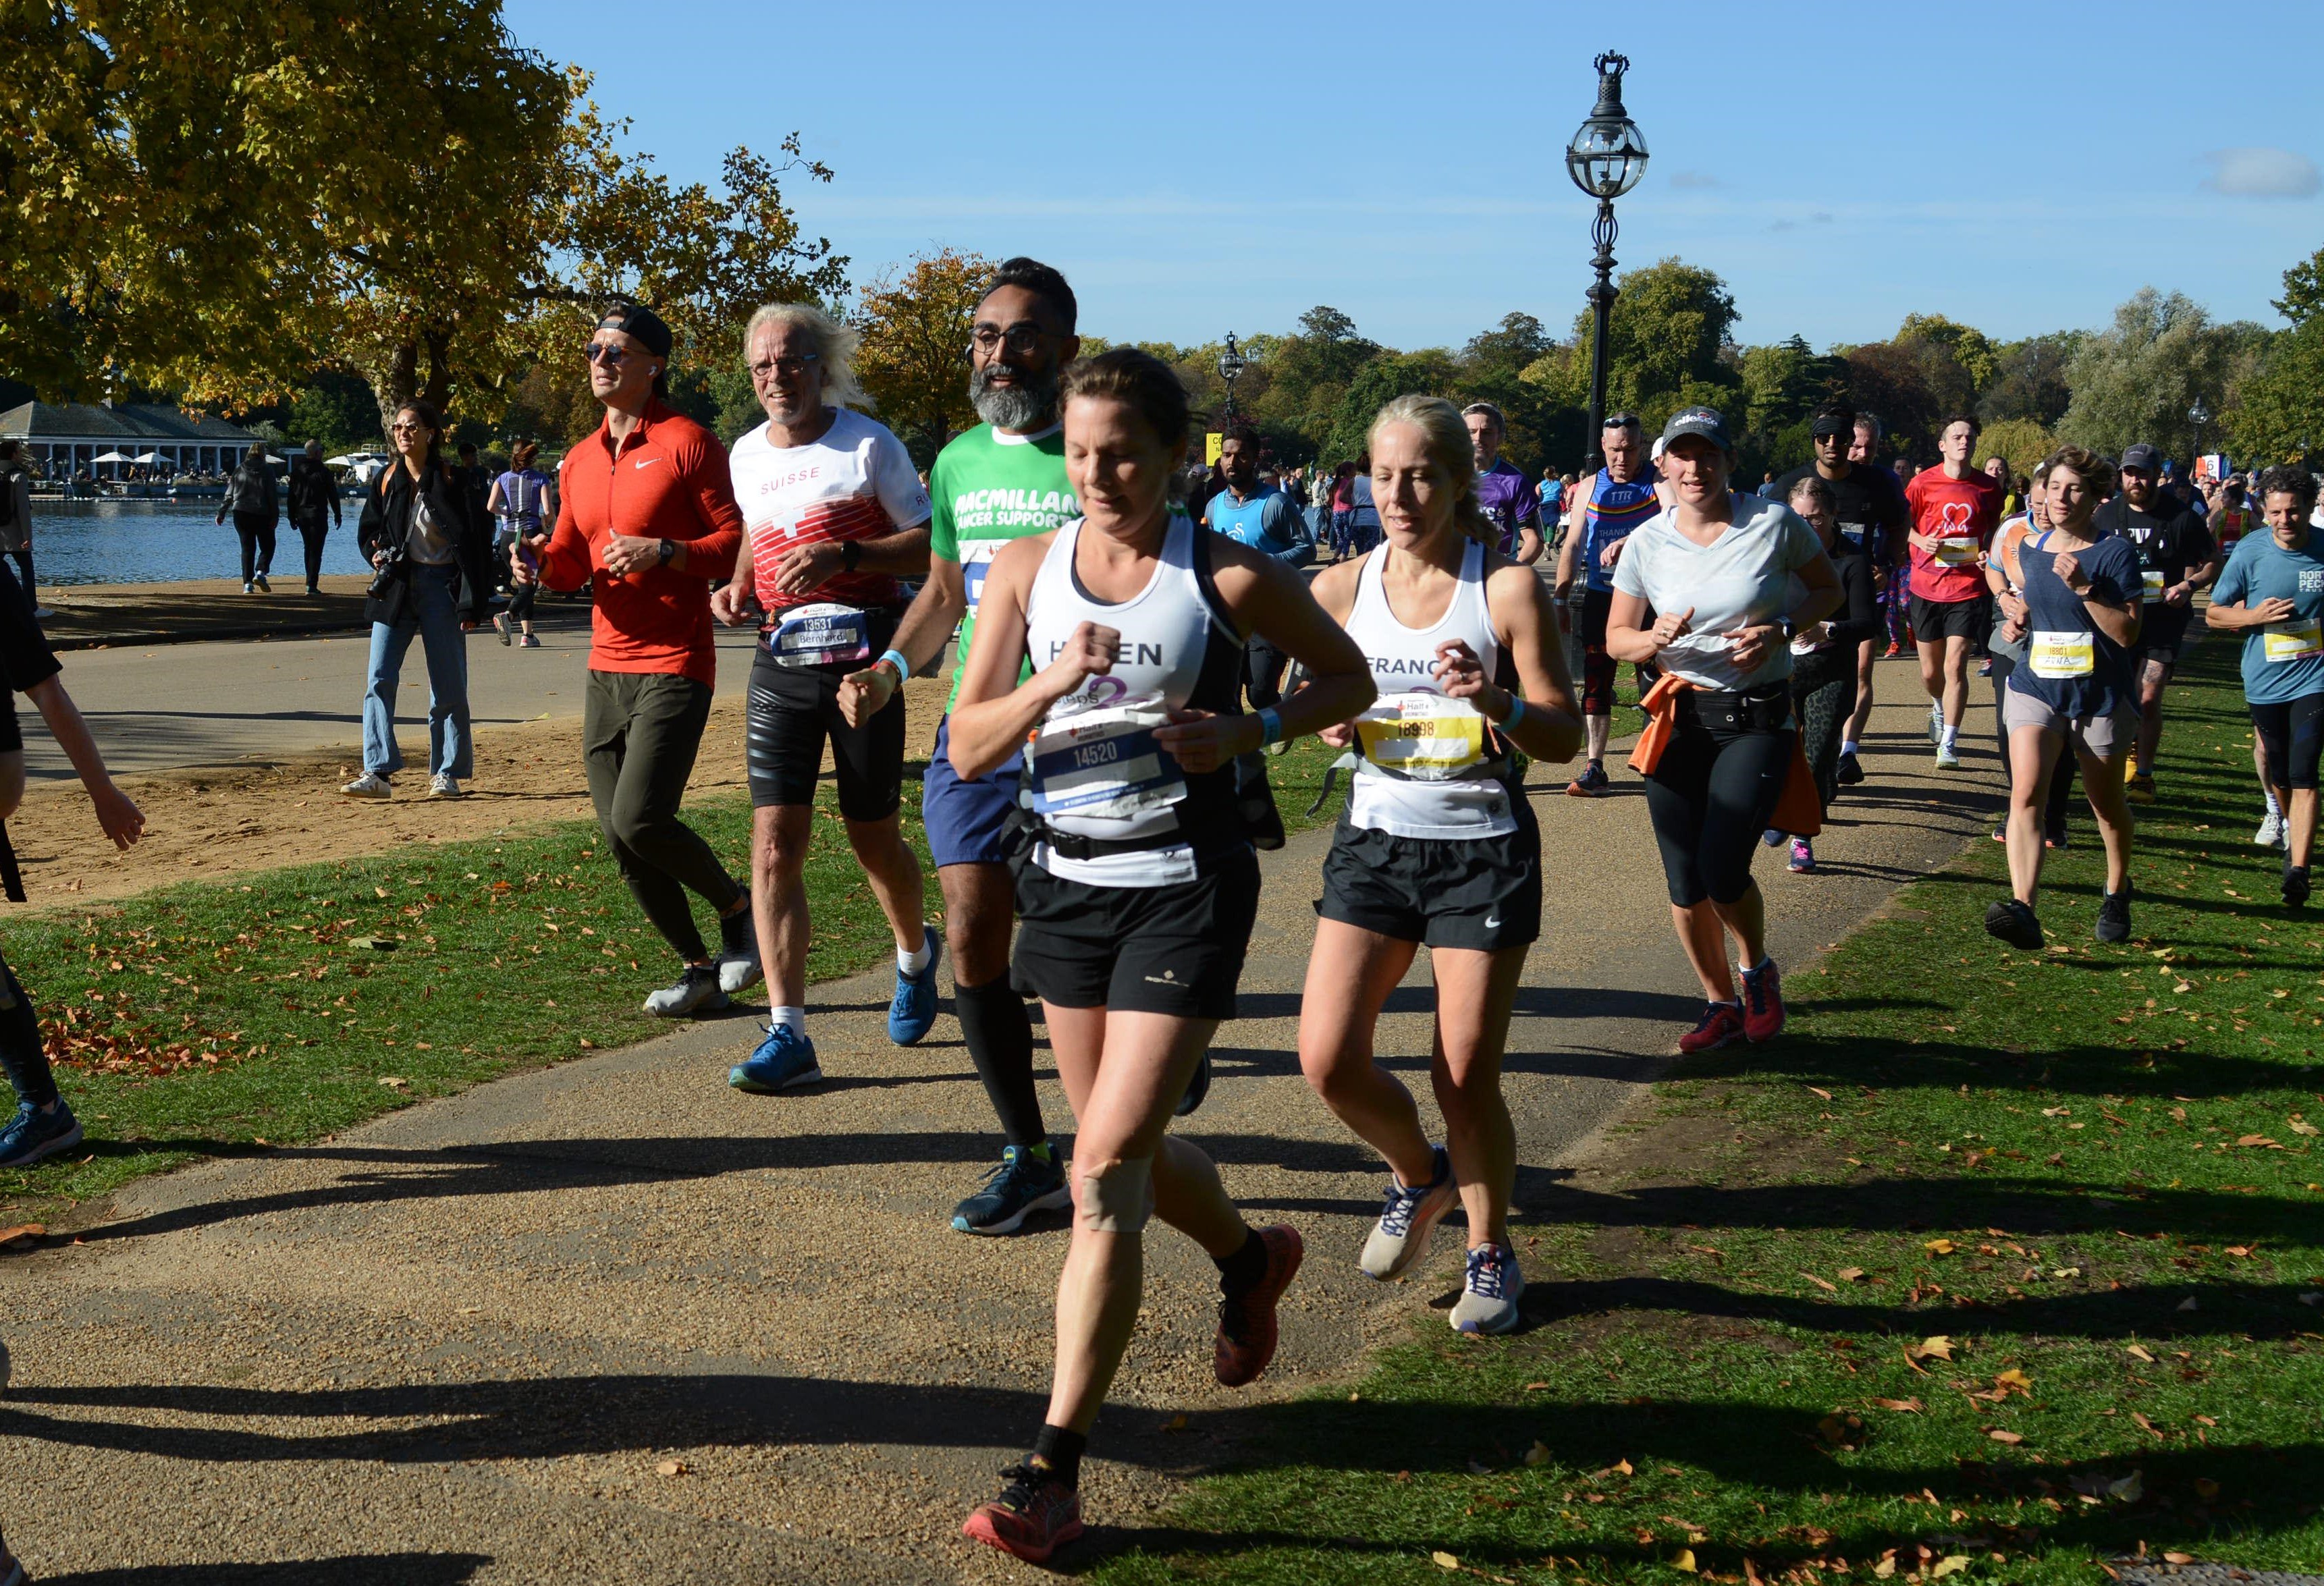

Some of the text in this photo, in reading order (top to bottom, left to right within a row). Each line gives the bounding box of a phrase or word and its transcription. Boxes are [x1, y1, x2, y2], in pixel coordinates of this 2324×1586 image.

[2207, 460, 2214, 470] 6
[760, 466, 820, 495] SUISSE
[954, 488, 1082, 518] MACMILLAN
[1611, 490, 1633, 501] TTR
[996, 510, 1072, 529] SUPPORT
[1599, 528, 1627, 537] THANK
[803, 618, 832, 631] 13531
[799, 632, 846, 643] Bernhard
[1050, 640, 1162, 666] HEN
[1073, 740, 1118, 768] 14520
